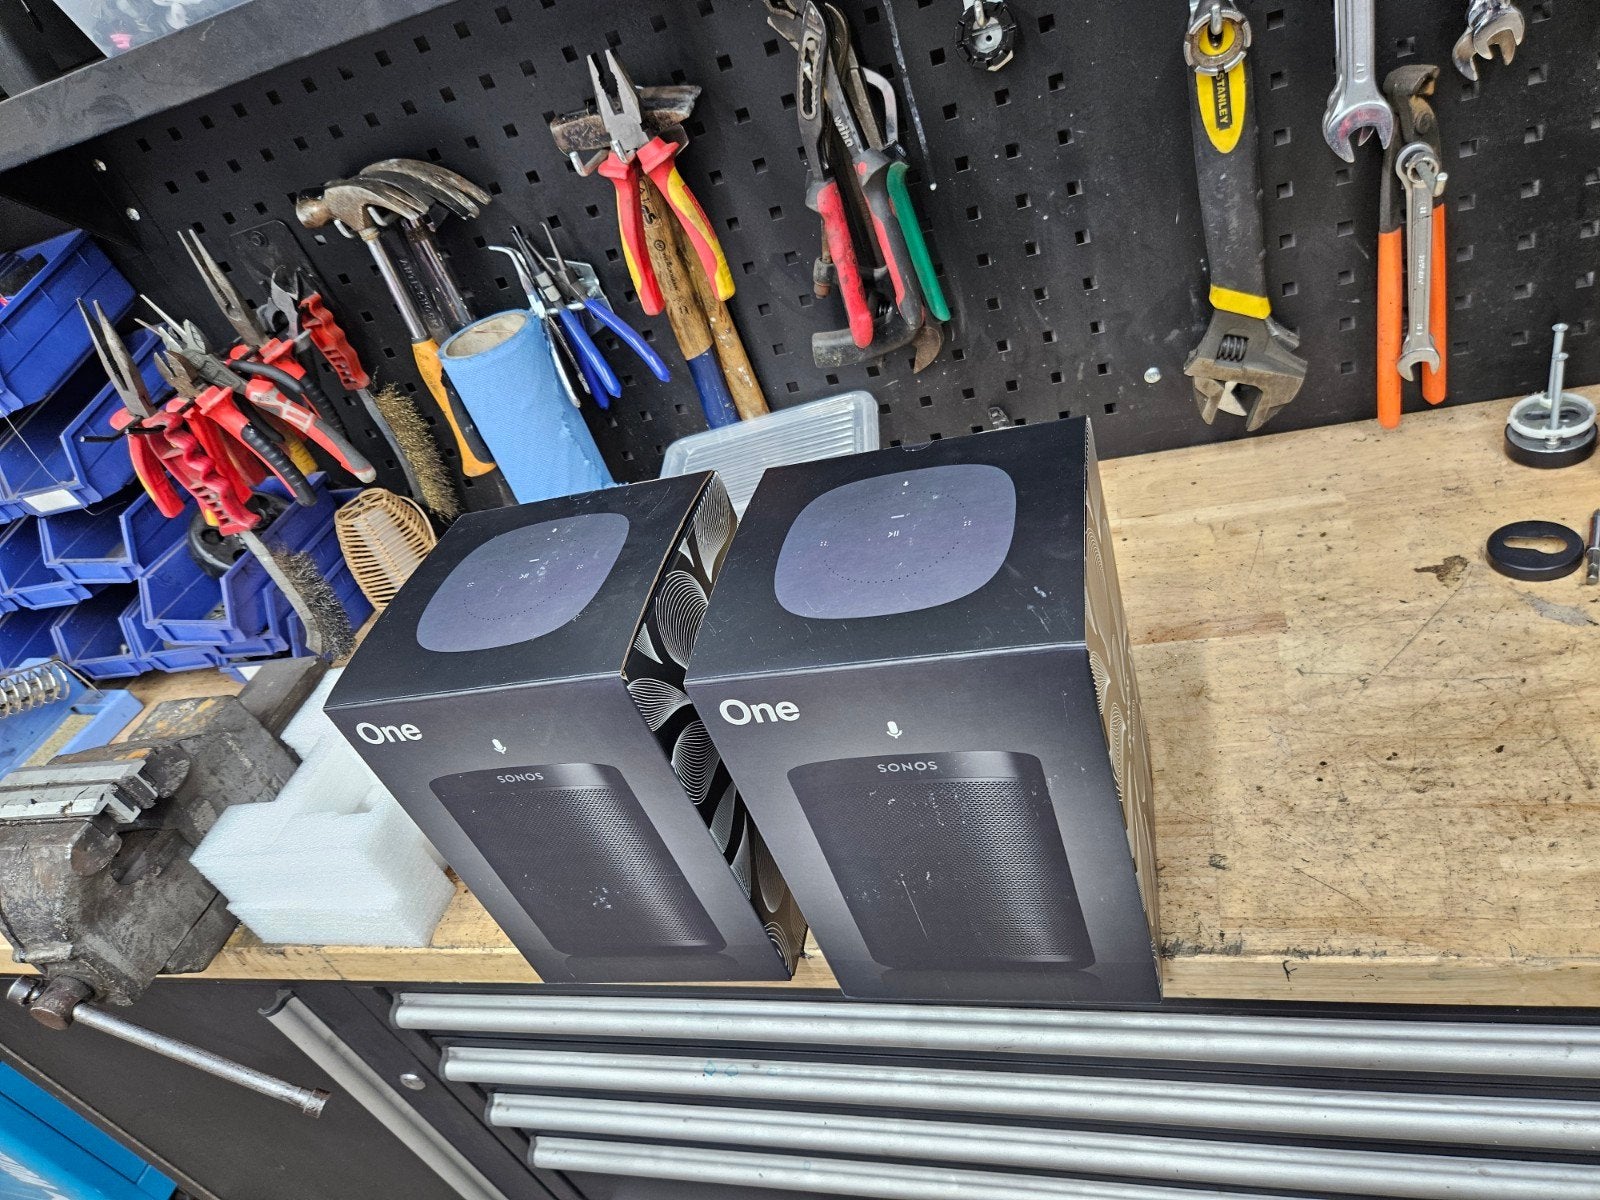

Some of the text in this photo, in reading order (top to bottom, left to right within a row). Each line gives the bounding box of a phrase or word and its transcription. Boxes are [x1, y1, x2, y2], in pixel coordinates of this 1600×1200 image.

[1215, 72, 1229, 123] STANLEY
[719, 698, 800, 726] One
[356, 722, 423, 745] One
[496, 772, 544, 784] SONOS
[877, 760, 938, 773] SONOS
